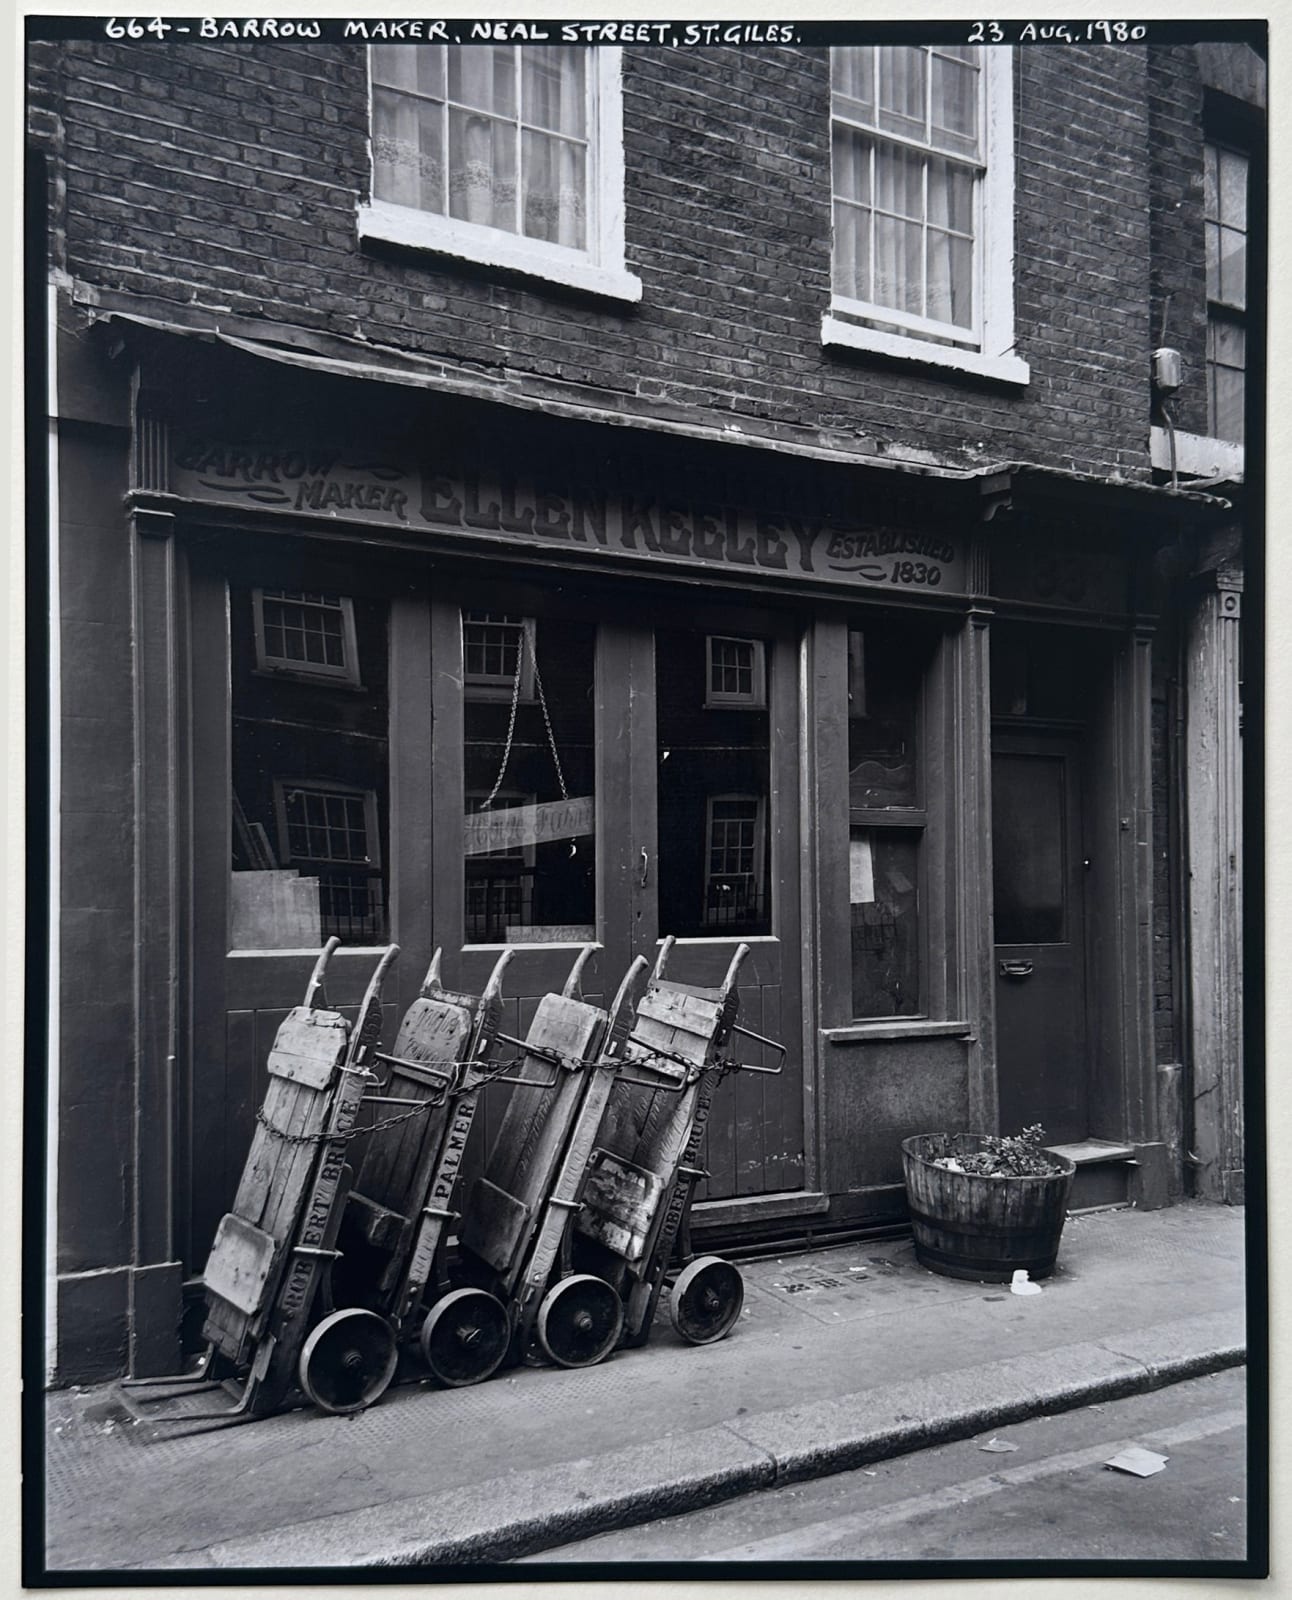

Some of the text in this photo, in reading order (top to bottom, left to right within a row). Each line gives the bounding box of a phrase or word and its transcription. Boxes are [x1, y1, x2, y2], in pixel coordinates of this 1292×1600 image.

[175, 444, 342, 483] BARROW
[294, 479, 408, 520] MAKER
[419, 462, 824, 572] ELLEN KEELEY
[827, 525, 955, 565] ESTABLISHED
[891, 561, 942, 586] 1830
[433, 1102, 475, 1199] PALMER
